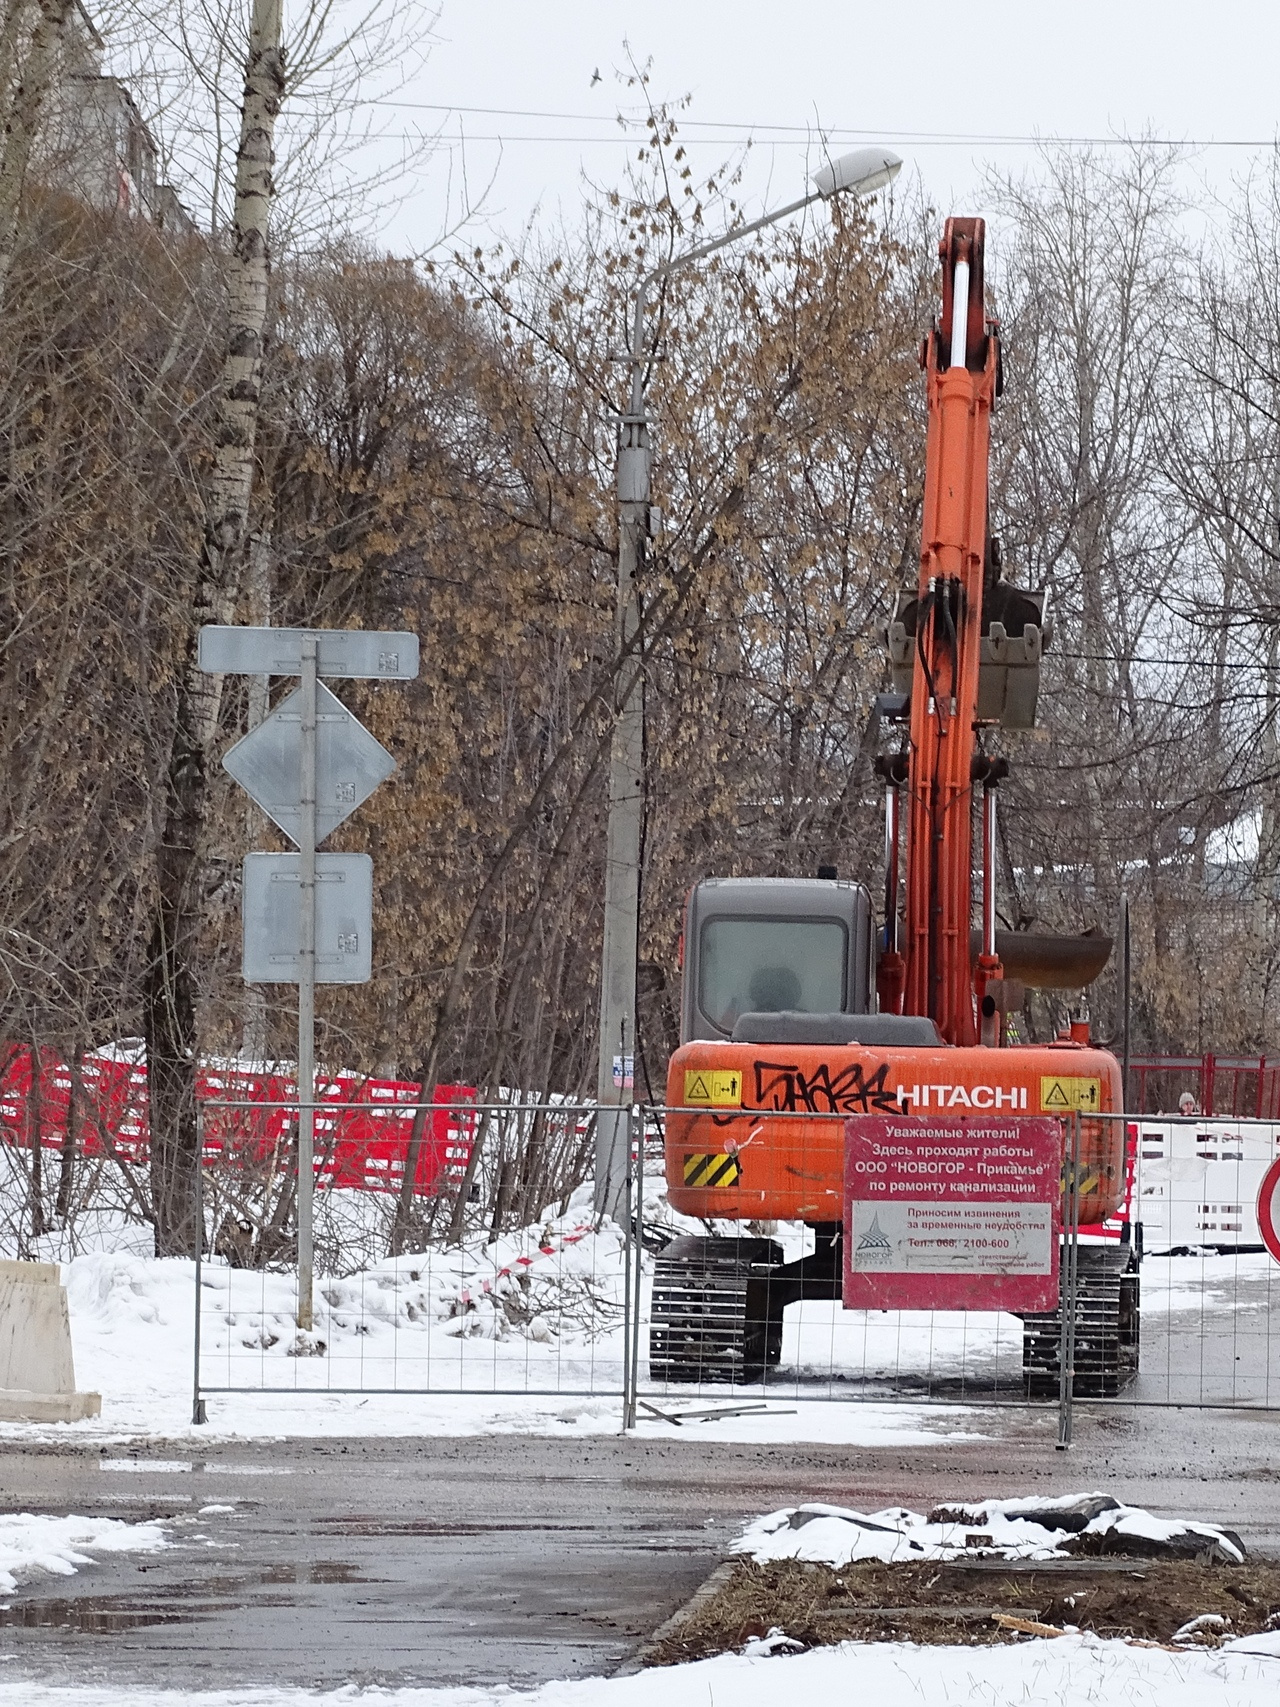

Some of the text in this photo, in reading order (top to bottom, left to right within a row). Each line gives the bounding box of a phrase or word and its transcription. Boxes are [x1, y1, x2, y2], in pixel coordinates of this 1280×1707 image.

[896, 1084, 1028, 1110] HITACHI
[885, 1125, 1020, 1139] Уважаемые жители!
[872, 1142, 1034, 1160] Здесь проходят работы
[855, 1160, 888, 1173] ООО
[869, 1181, 1036, 1195] по ремонту канализации
[907, 1207, 1021, 1219] Приносим извинения
[906, 1221, 1046, 1232] за временные неудобства
[963, 1238, 1010, 1249] 2100-600
